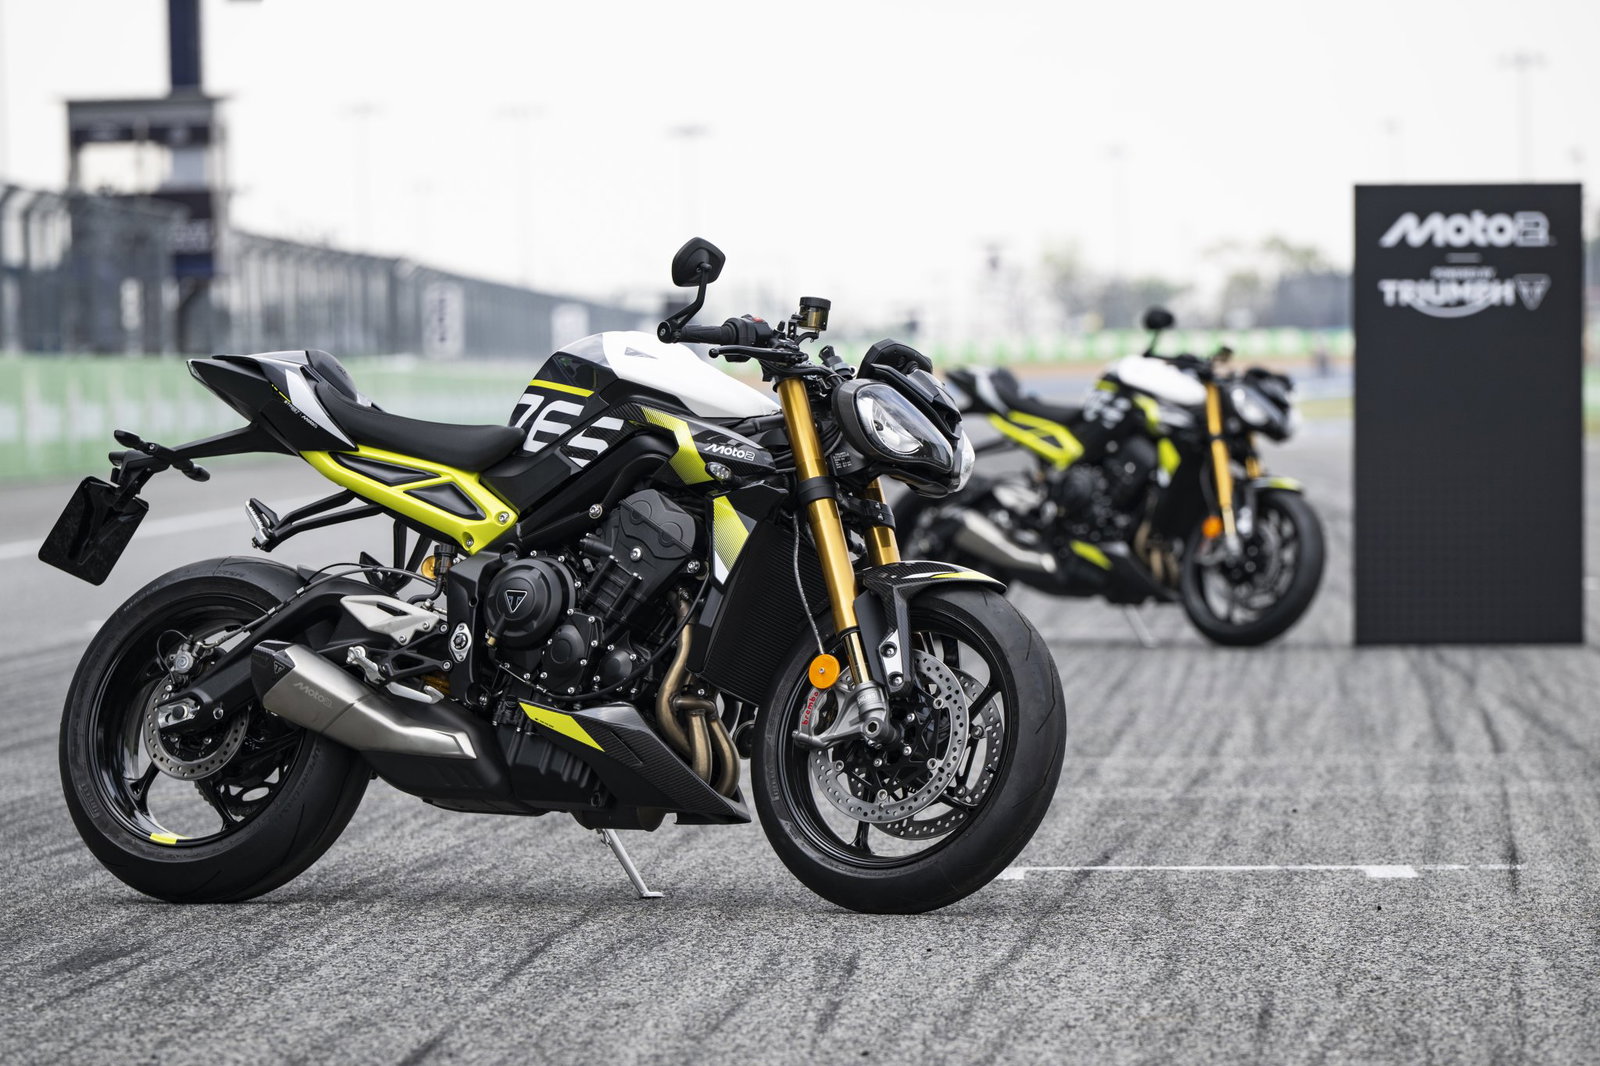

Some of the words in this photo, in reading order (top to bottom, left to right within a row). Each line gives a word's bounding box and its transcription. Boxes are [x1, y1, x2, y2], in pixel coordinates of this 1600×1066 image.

[1378, 278, 1516, 317] TRIUMPH
[704, 443, 755, 462] Moto2
[801, 691, 819, 726] brembo
